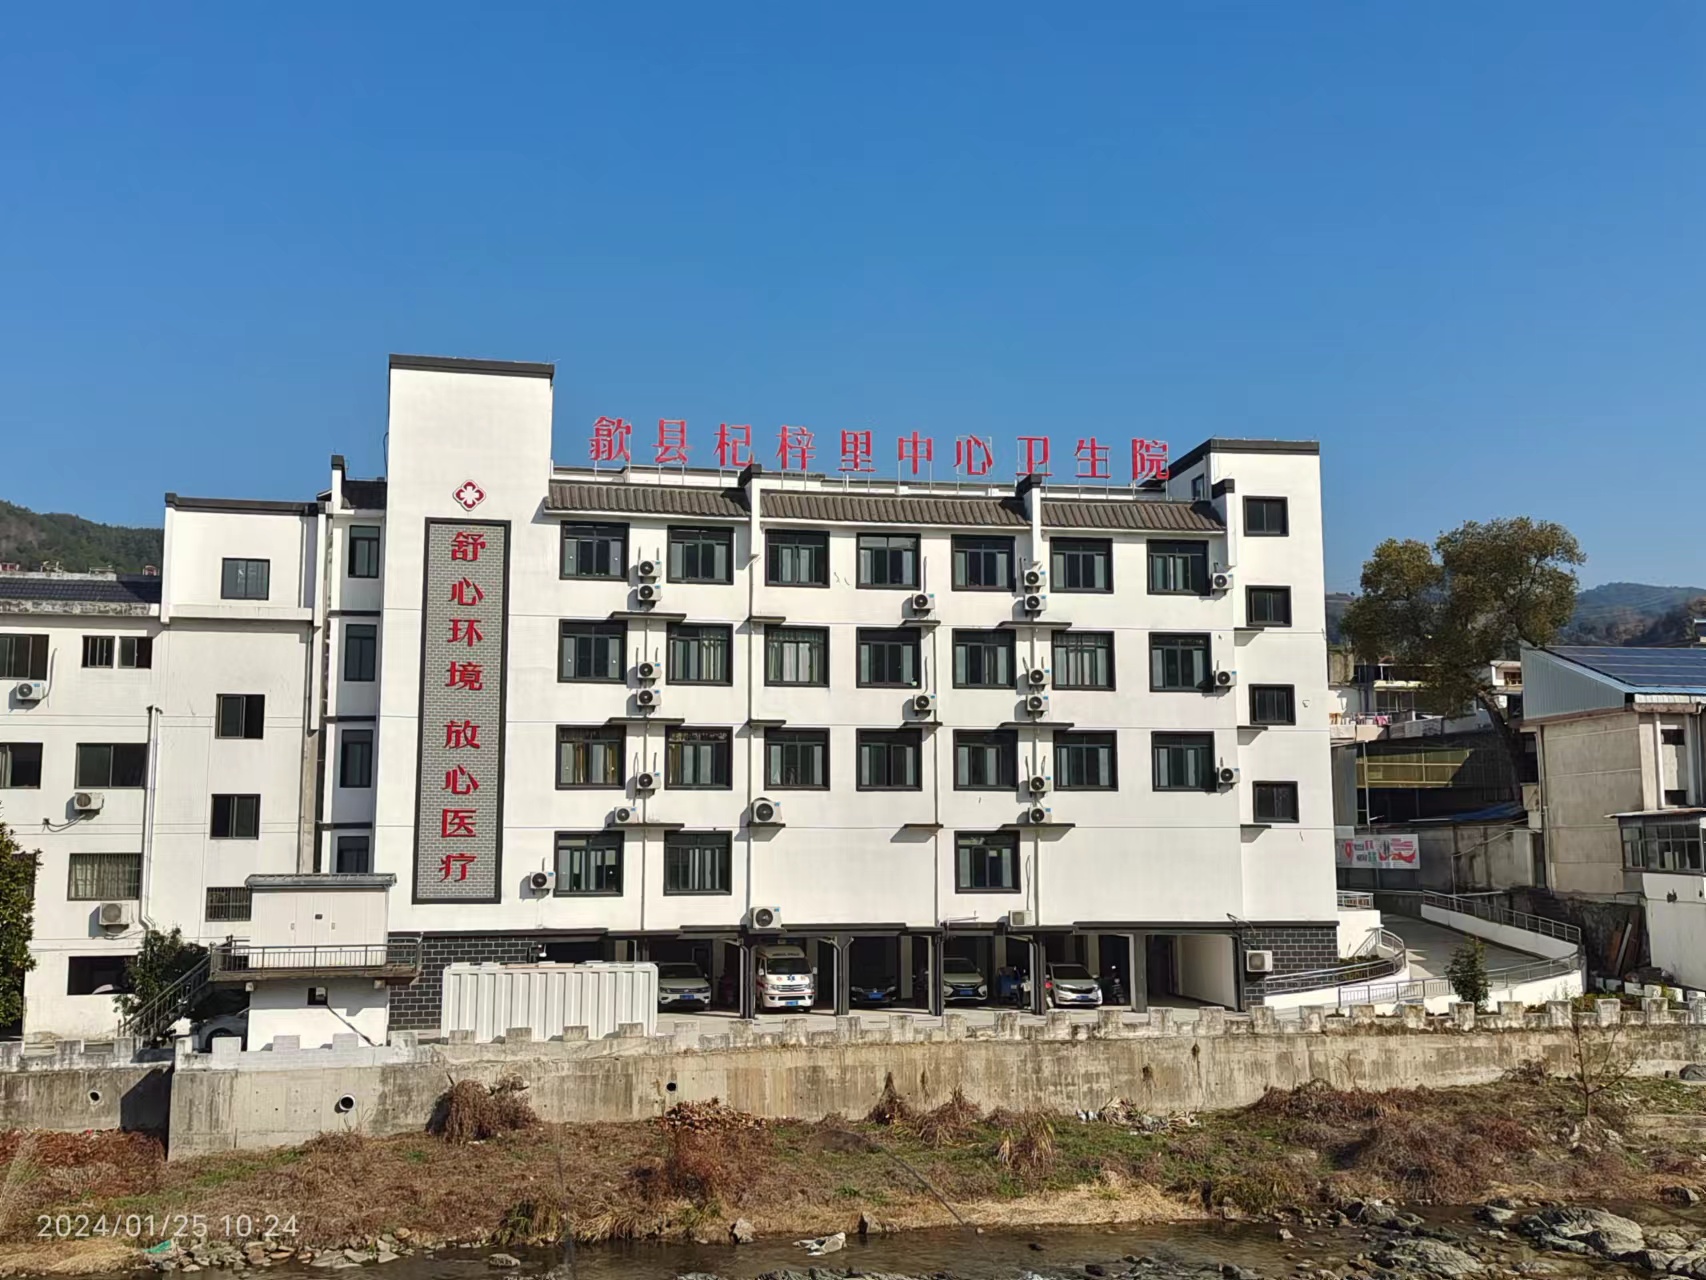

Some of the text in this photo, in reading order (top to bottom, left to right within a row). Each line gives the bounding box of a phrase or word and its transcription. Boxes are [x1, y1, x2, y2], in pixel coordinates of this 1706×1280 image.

[589, 416, 1170, 480] 歙县杞梓里中心卫生院
[439, 531, 486, 882] 舒心环境 放心医疗
